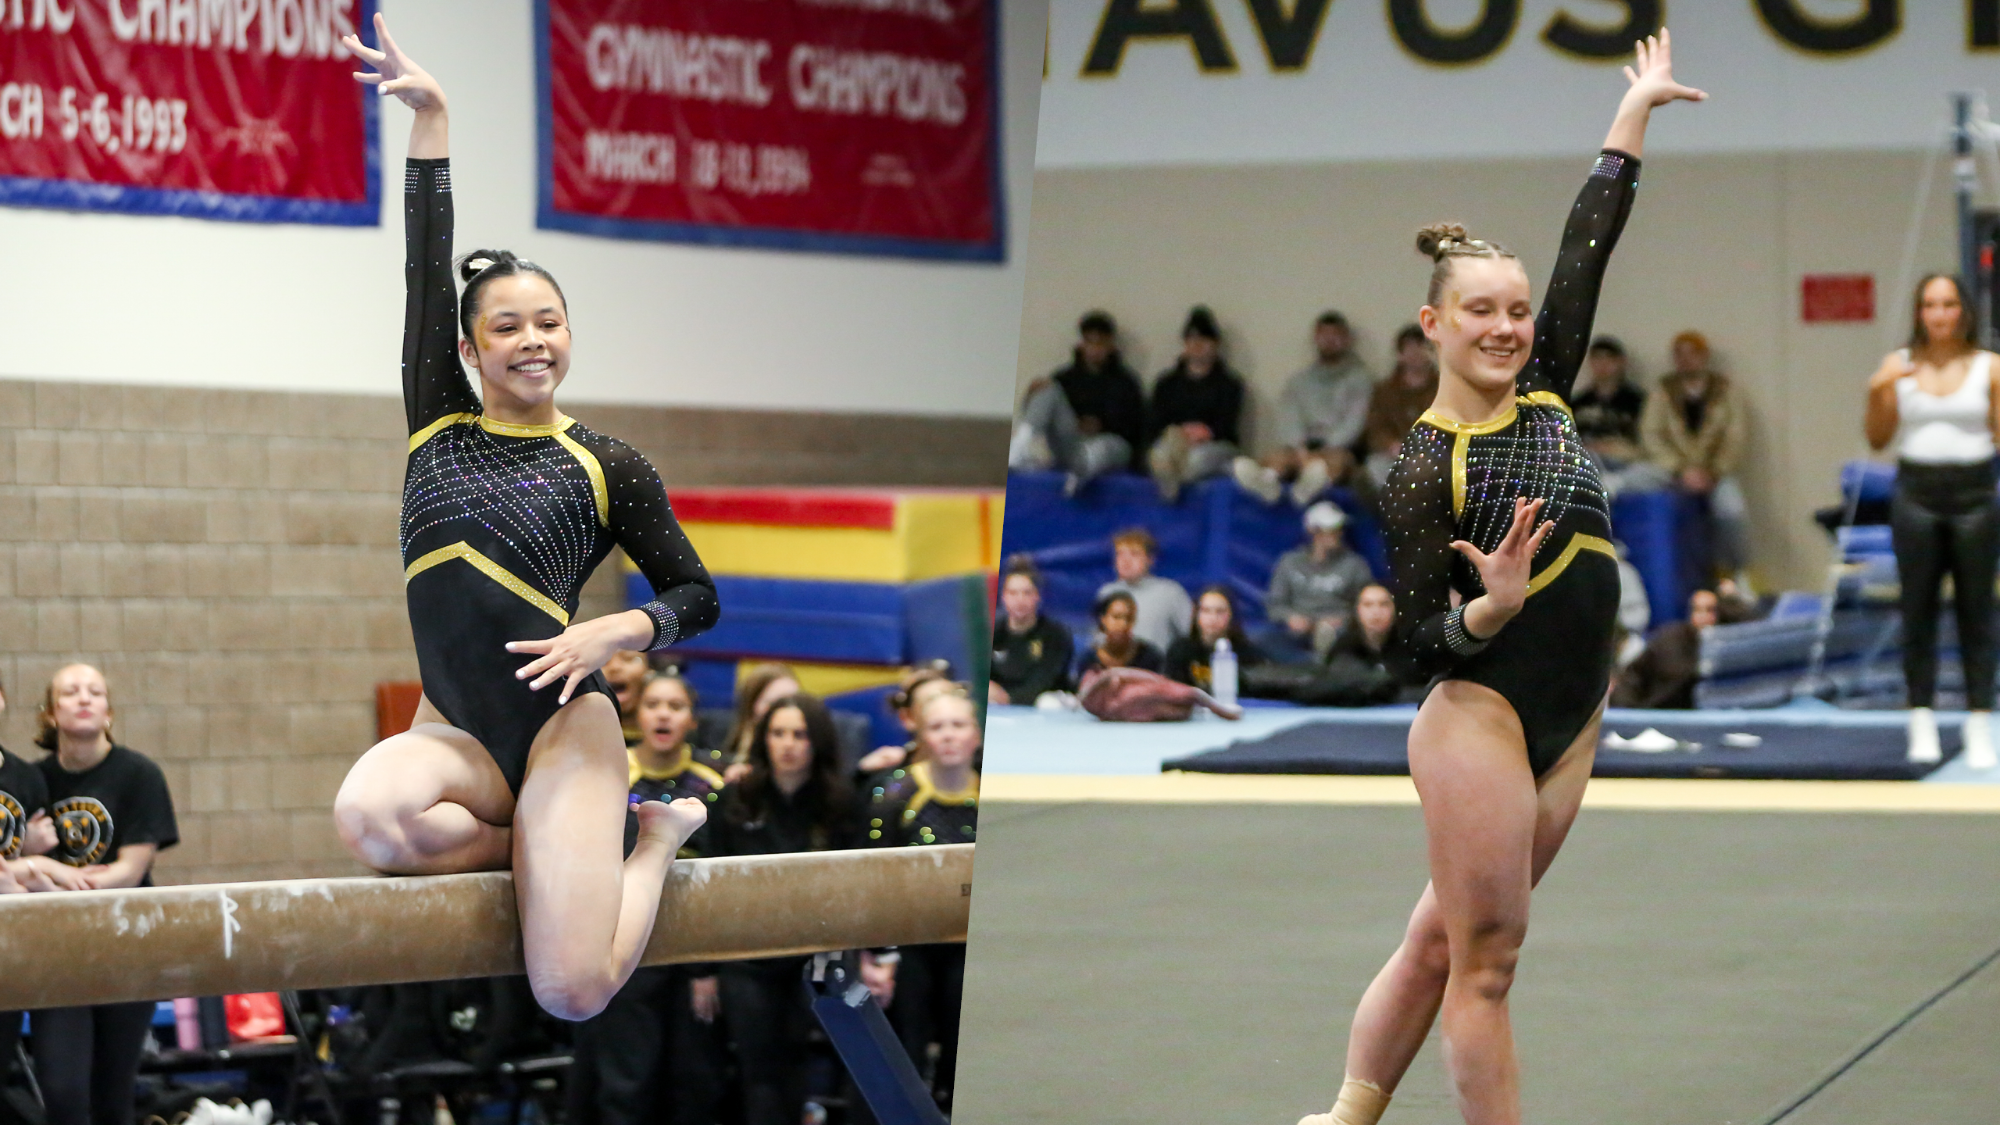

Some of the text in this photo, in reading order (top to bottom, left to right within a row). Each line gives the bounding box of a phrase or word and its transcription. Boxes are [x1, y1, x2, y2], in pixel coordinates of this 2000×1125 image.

[0, 0, 356, 61] TIC CHAMPIONS
[1042, 0, 1664, 77] AVUS
[586, 23, 967, 126] GYMNASTIC CHAMPIONS
[60, 86, 188, 153] 5-6,1993
[584, 128, 676, 183] MARCH
